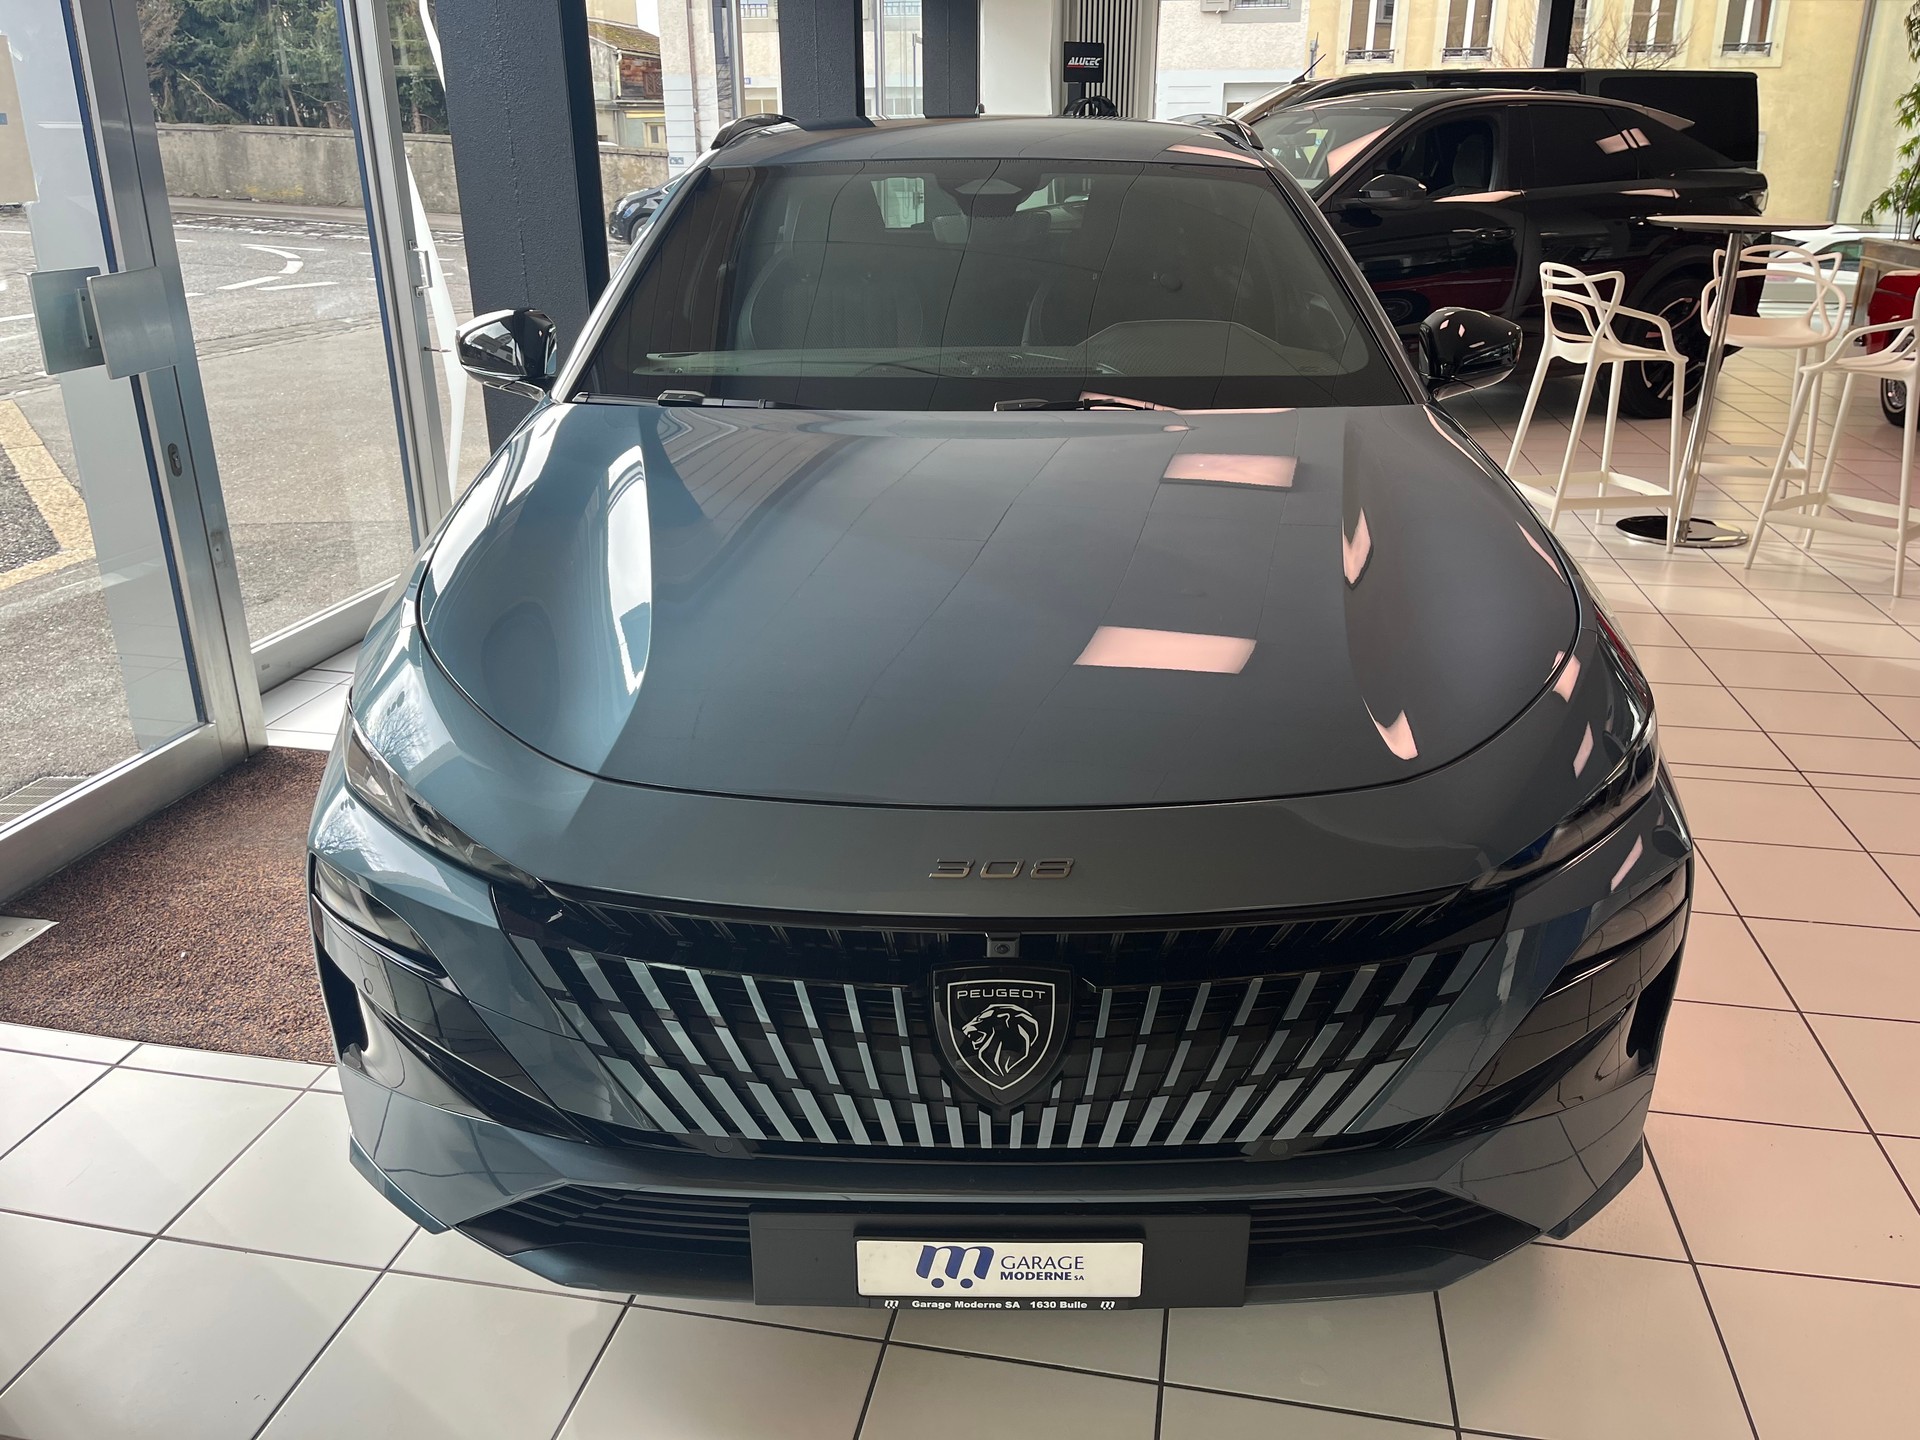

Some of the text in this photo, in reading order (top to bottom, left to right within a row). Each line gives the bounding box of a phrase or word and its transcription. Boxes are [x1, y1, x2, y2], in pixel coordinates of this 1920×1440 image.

[1068, 57, 1102, 65] ALUTEC
[928, 857, 1075, 879] 308
[957, 988, 1046, 1000] PEUGEOT
[1001, 1256, 1084, 1269] GARAGE
[1000, 1271, 1072, 1281] MODERNE
[912, 1300, 951, 1309] Garage
